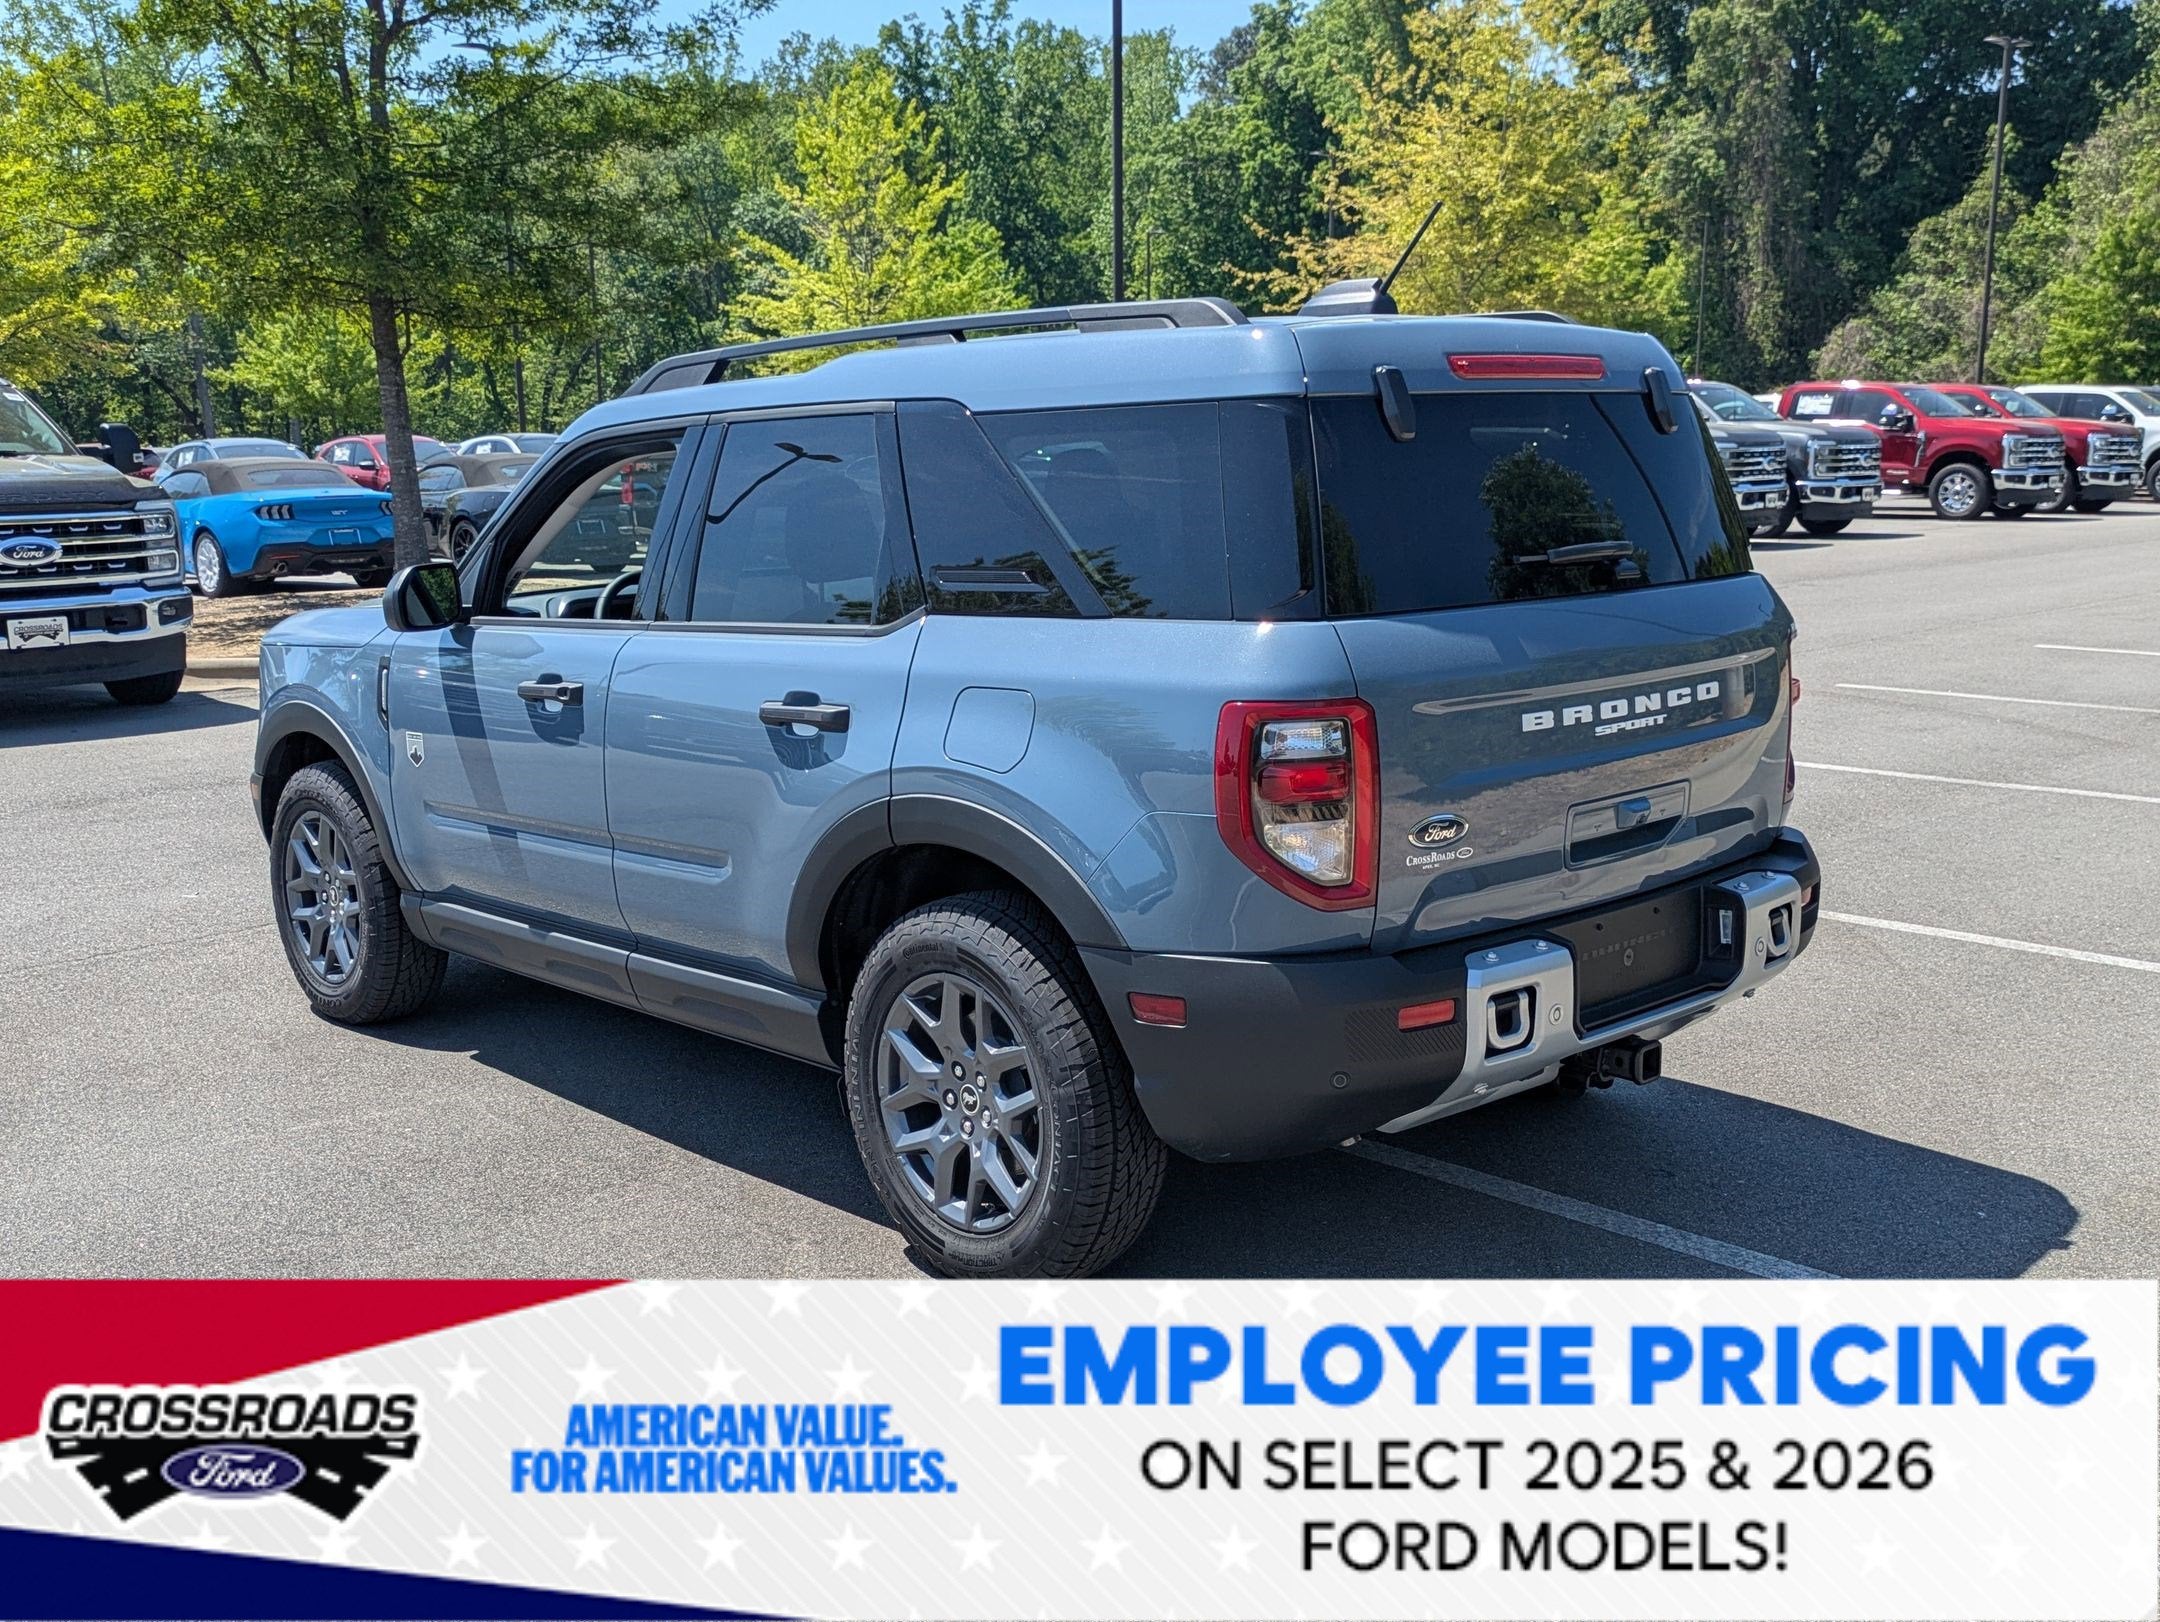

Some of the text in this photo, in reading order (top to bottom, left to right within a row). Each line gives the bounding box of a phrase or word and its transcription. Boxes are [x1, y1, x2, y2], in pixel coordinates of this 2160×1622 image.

[13, 545, 45, 559] Ford
[14, 623, 63, 635] CROSSROADS
[1522, 681, 1719, 732] BRONCO
[1595, 714, 1667, 736] SPORT
[1425, 822, 1457, 842] Ford
